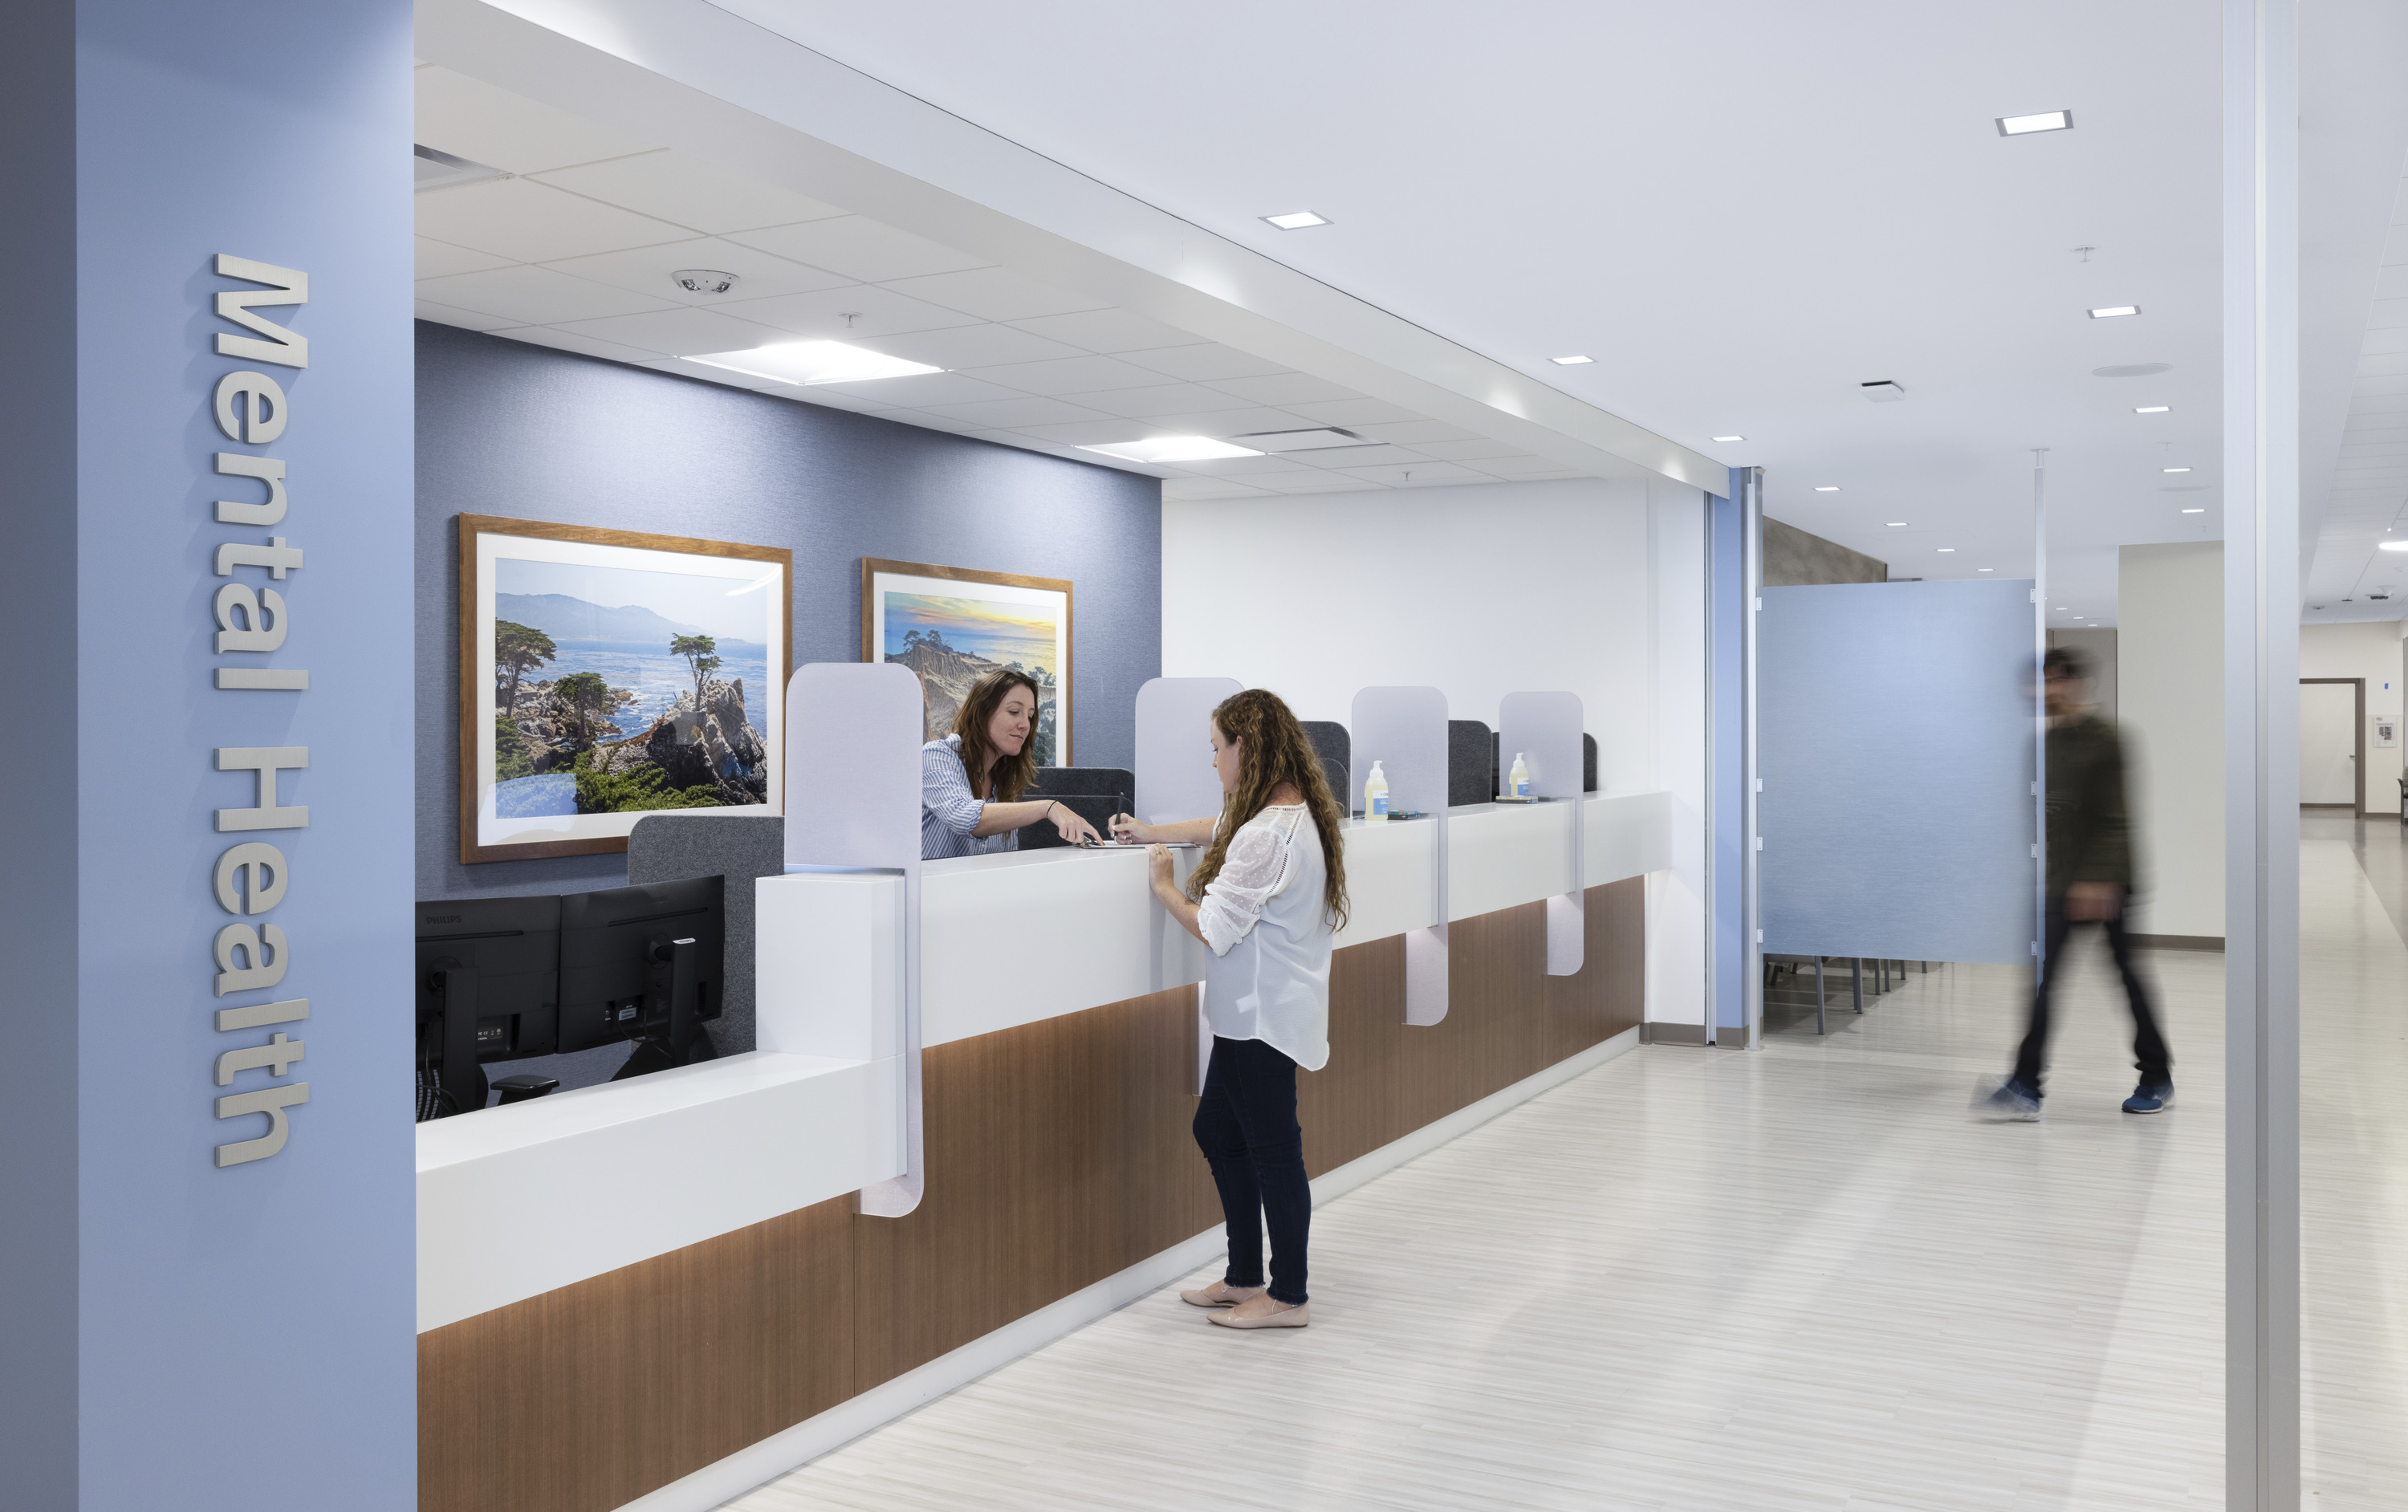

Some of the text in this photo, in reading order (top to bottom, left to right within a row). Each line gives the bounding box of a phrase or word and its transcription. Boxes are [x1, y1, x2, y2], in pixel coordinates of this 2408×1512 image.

[212, 253, 310, 1168] Mental Health
[426, 914, 462, 925] PHILIPS
